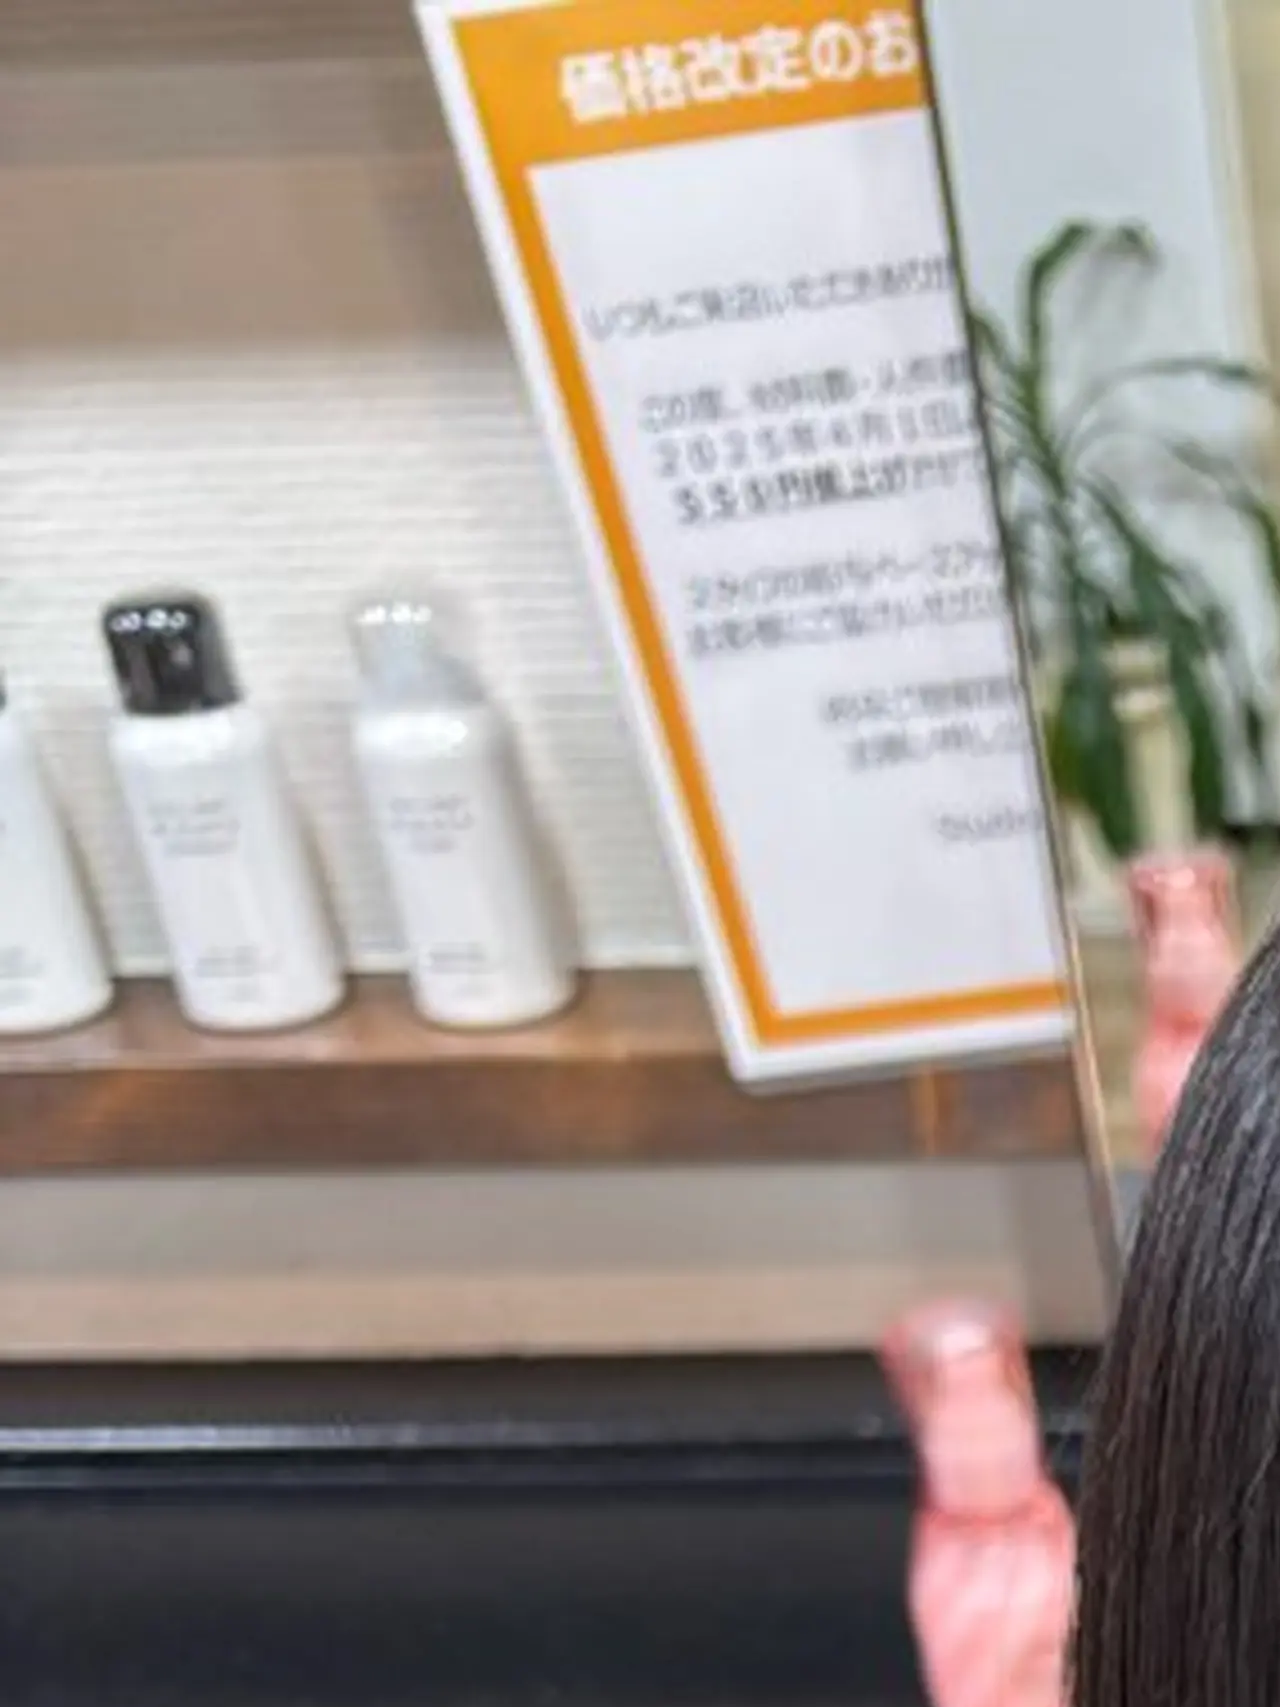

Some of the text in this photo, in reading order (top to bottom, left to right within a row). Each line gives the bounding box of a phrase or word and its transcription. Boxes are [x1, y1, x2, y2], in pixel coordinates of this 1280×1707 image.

[562, 10, 918, 126] 価格改定のお
